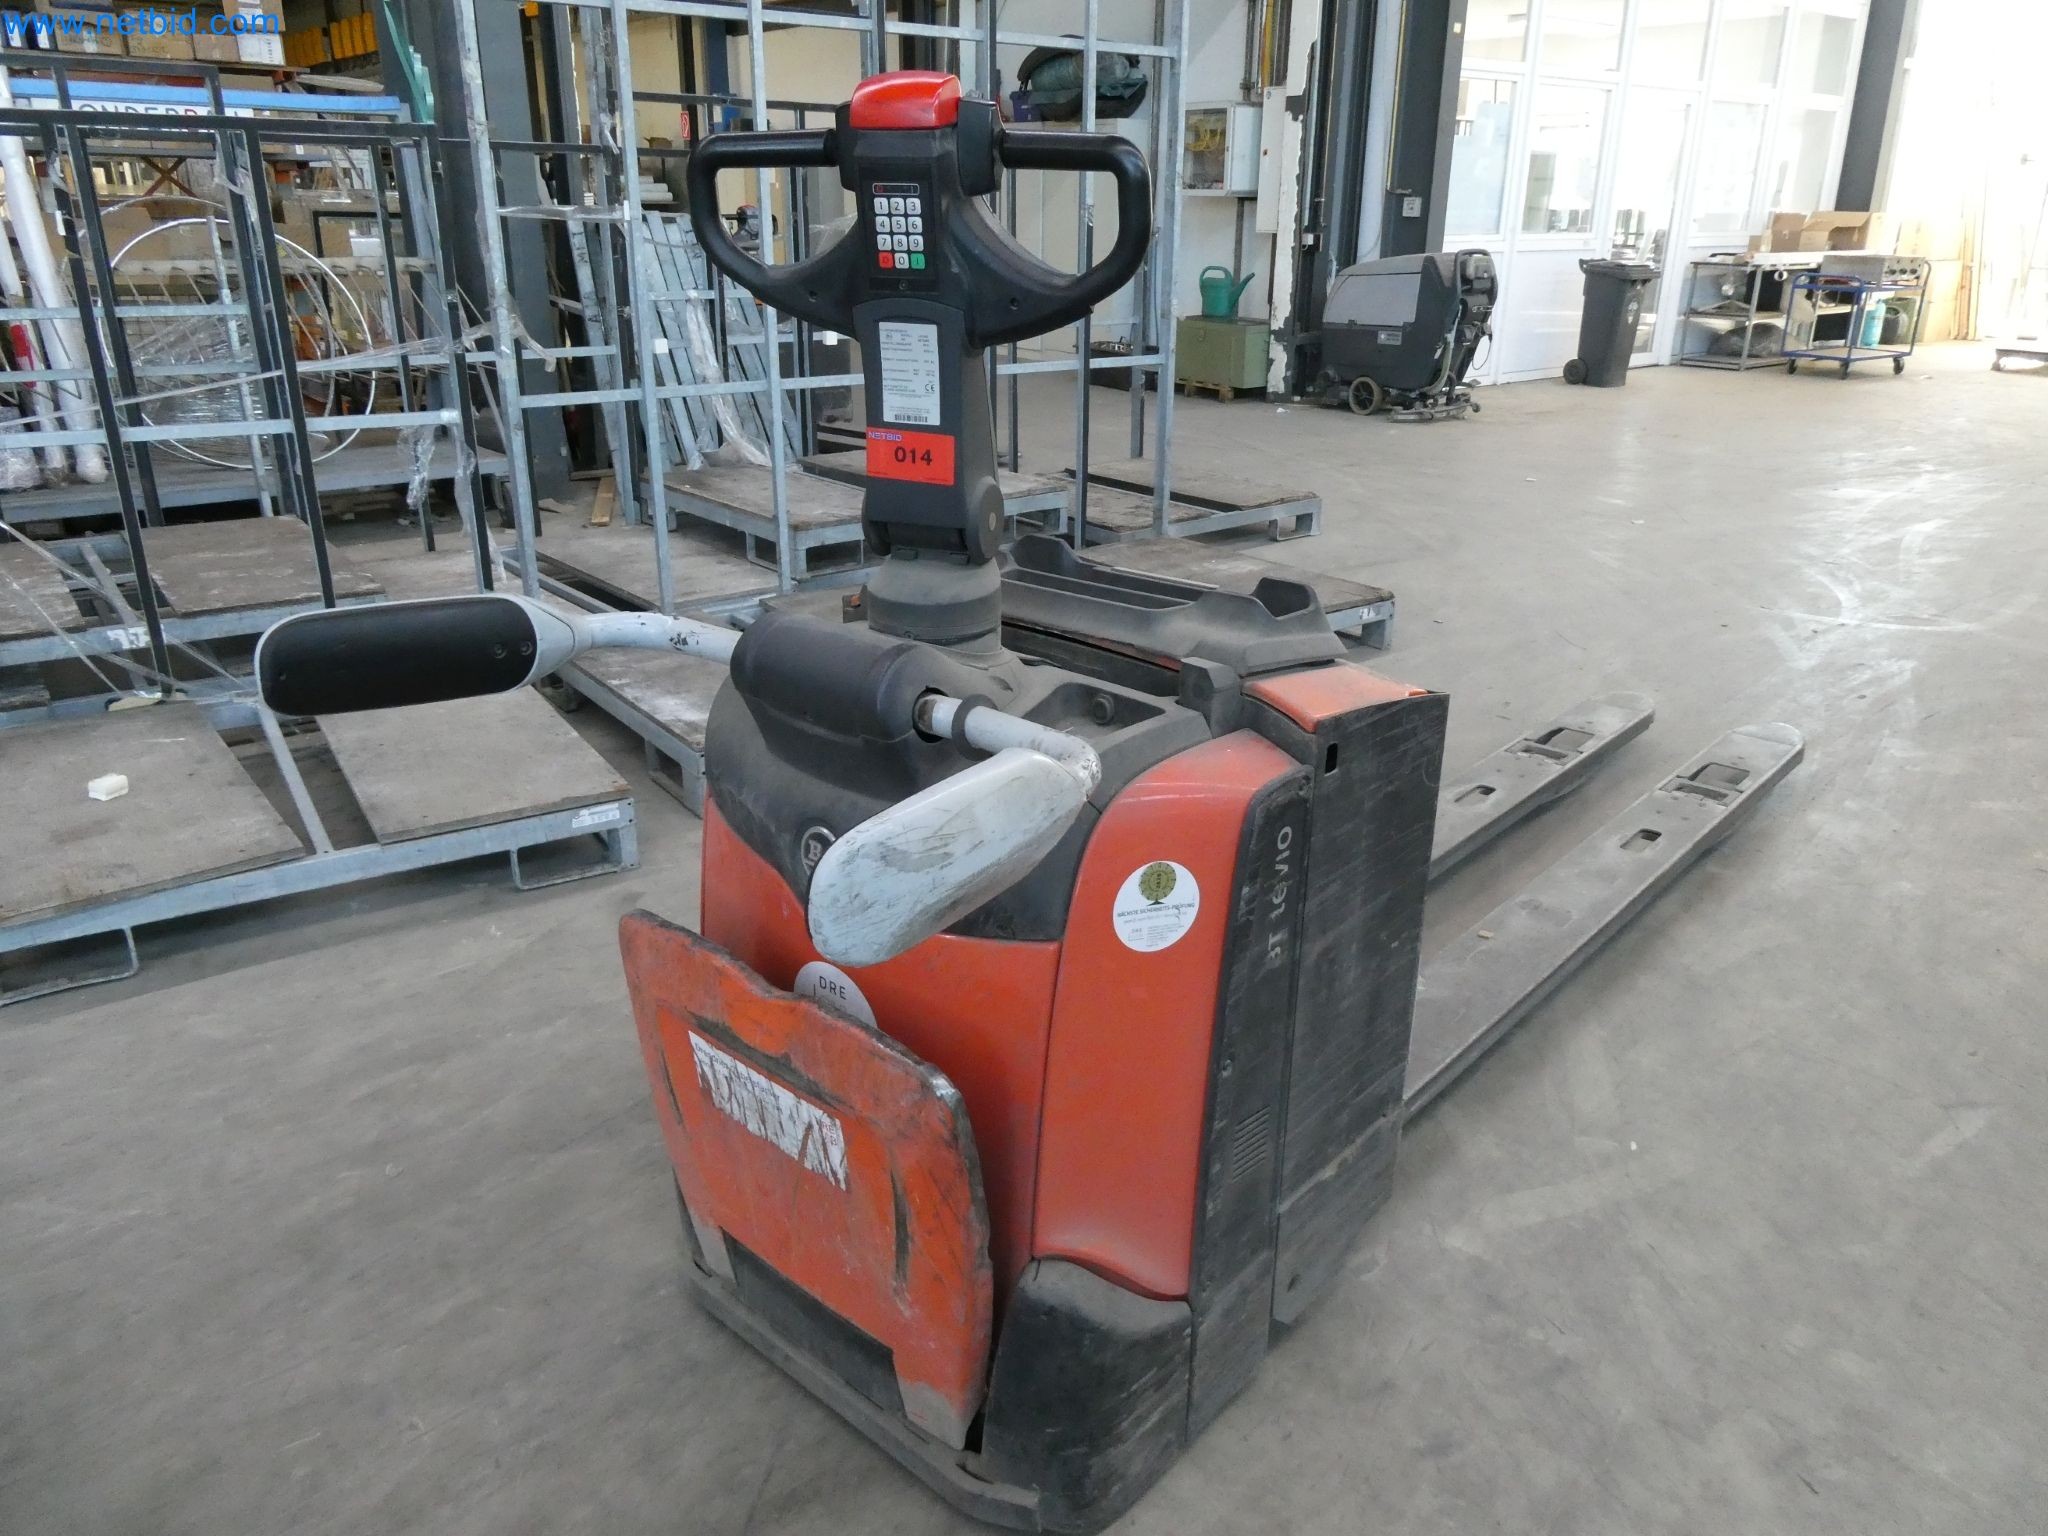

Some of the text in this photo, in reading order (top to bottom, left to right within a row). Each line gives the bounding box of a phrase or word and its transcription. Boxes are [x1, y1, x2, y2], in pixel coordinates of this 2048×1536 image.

[894, 201, 901, 211] 2
[910, 201, 916, 211] 3
[879, 220, 918, 230] 4 5 6
[881, 238, 919, 247] 7 8 9
[868, 431, 903, 442] NETBID
[894, 446, 933, 466] 014
[819, 975, 847, 1000] DRE
